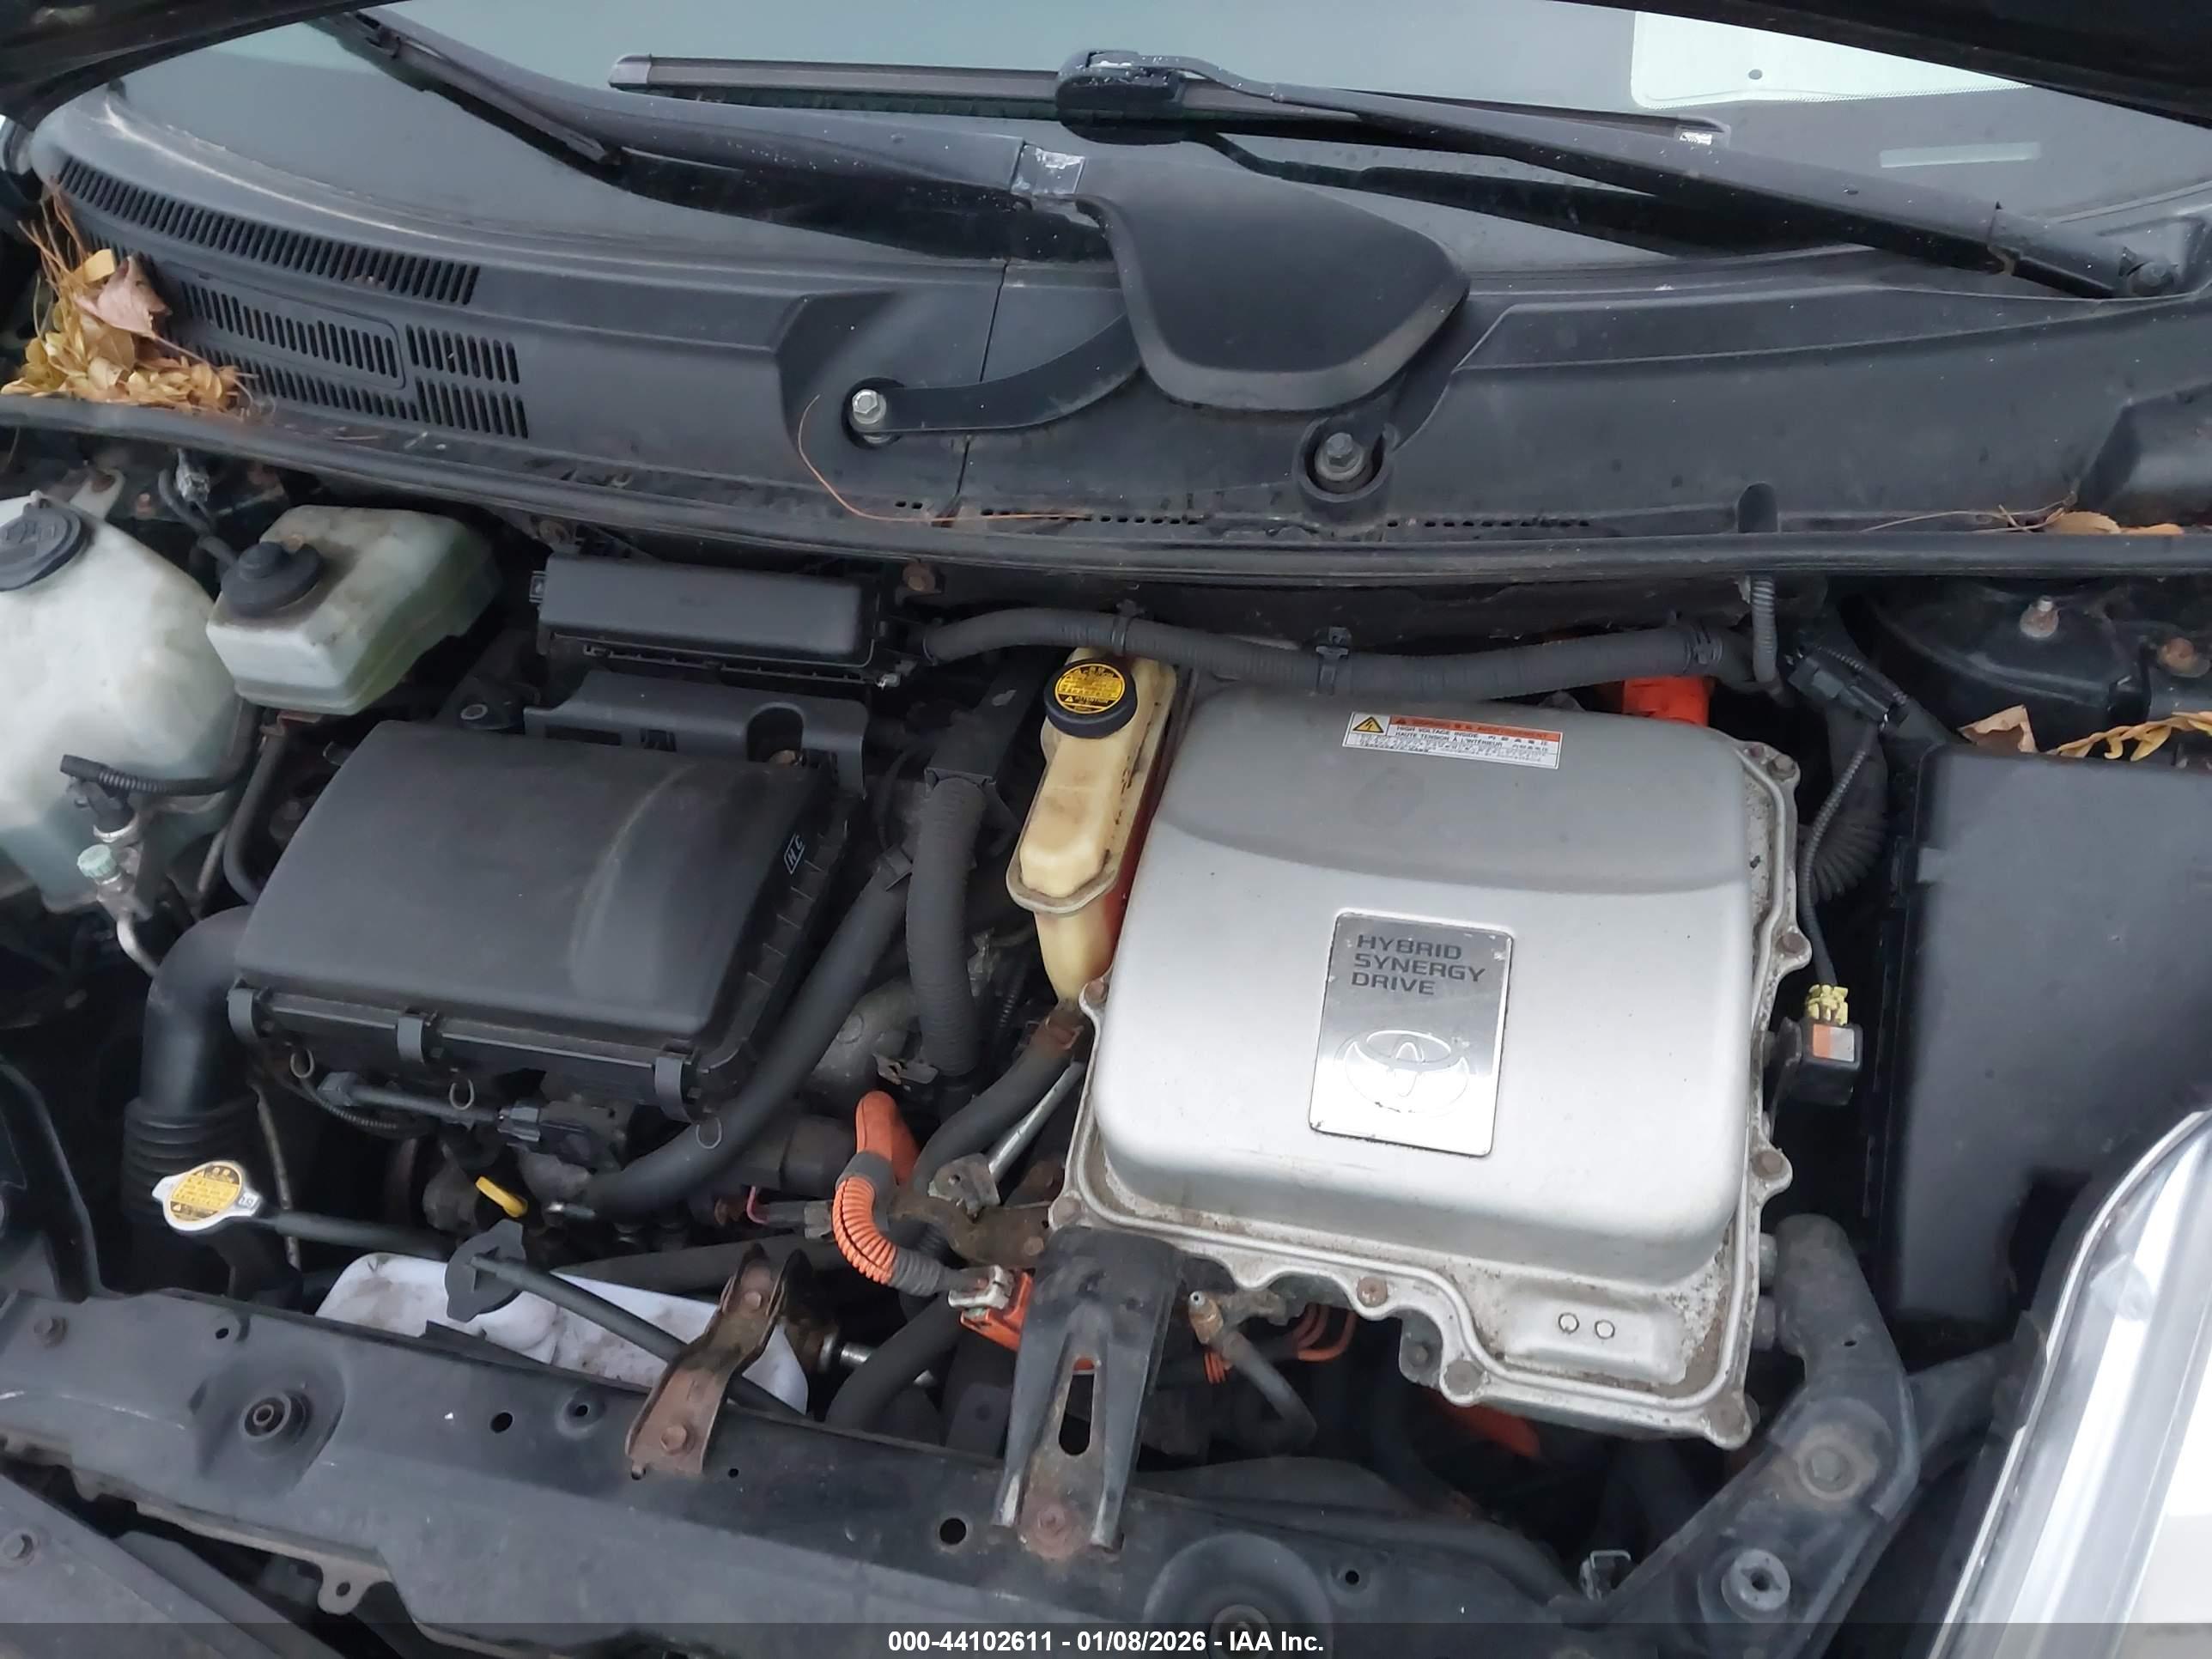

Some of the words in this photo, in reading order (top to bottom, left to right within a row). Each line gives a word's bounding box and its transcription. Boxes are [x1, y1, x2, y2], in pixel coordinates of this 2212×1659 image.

[1357, 934, 1462, 960] HYBRID
[1354, 952, 1486, 982] SYNERGY
[1352, 971, 1436, 995] DRIVE
